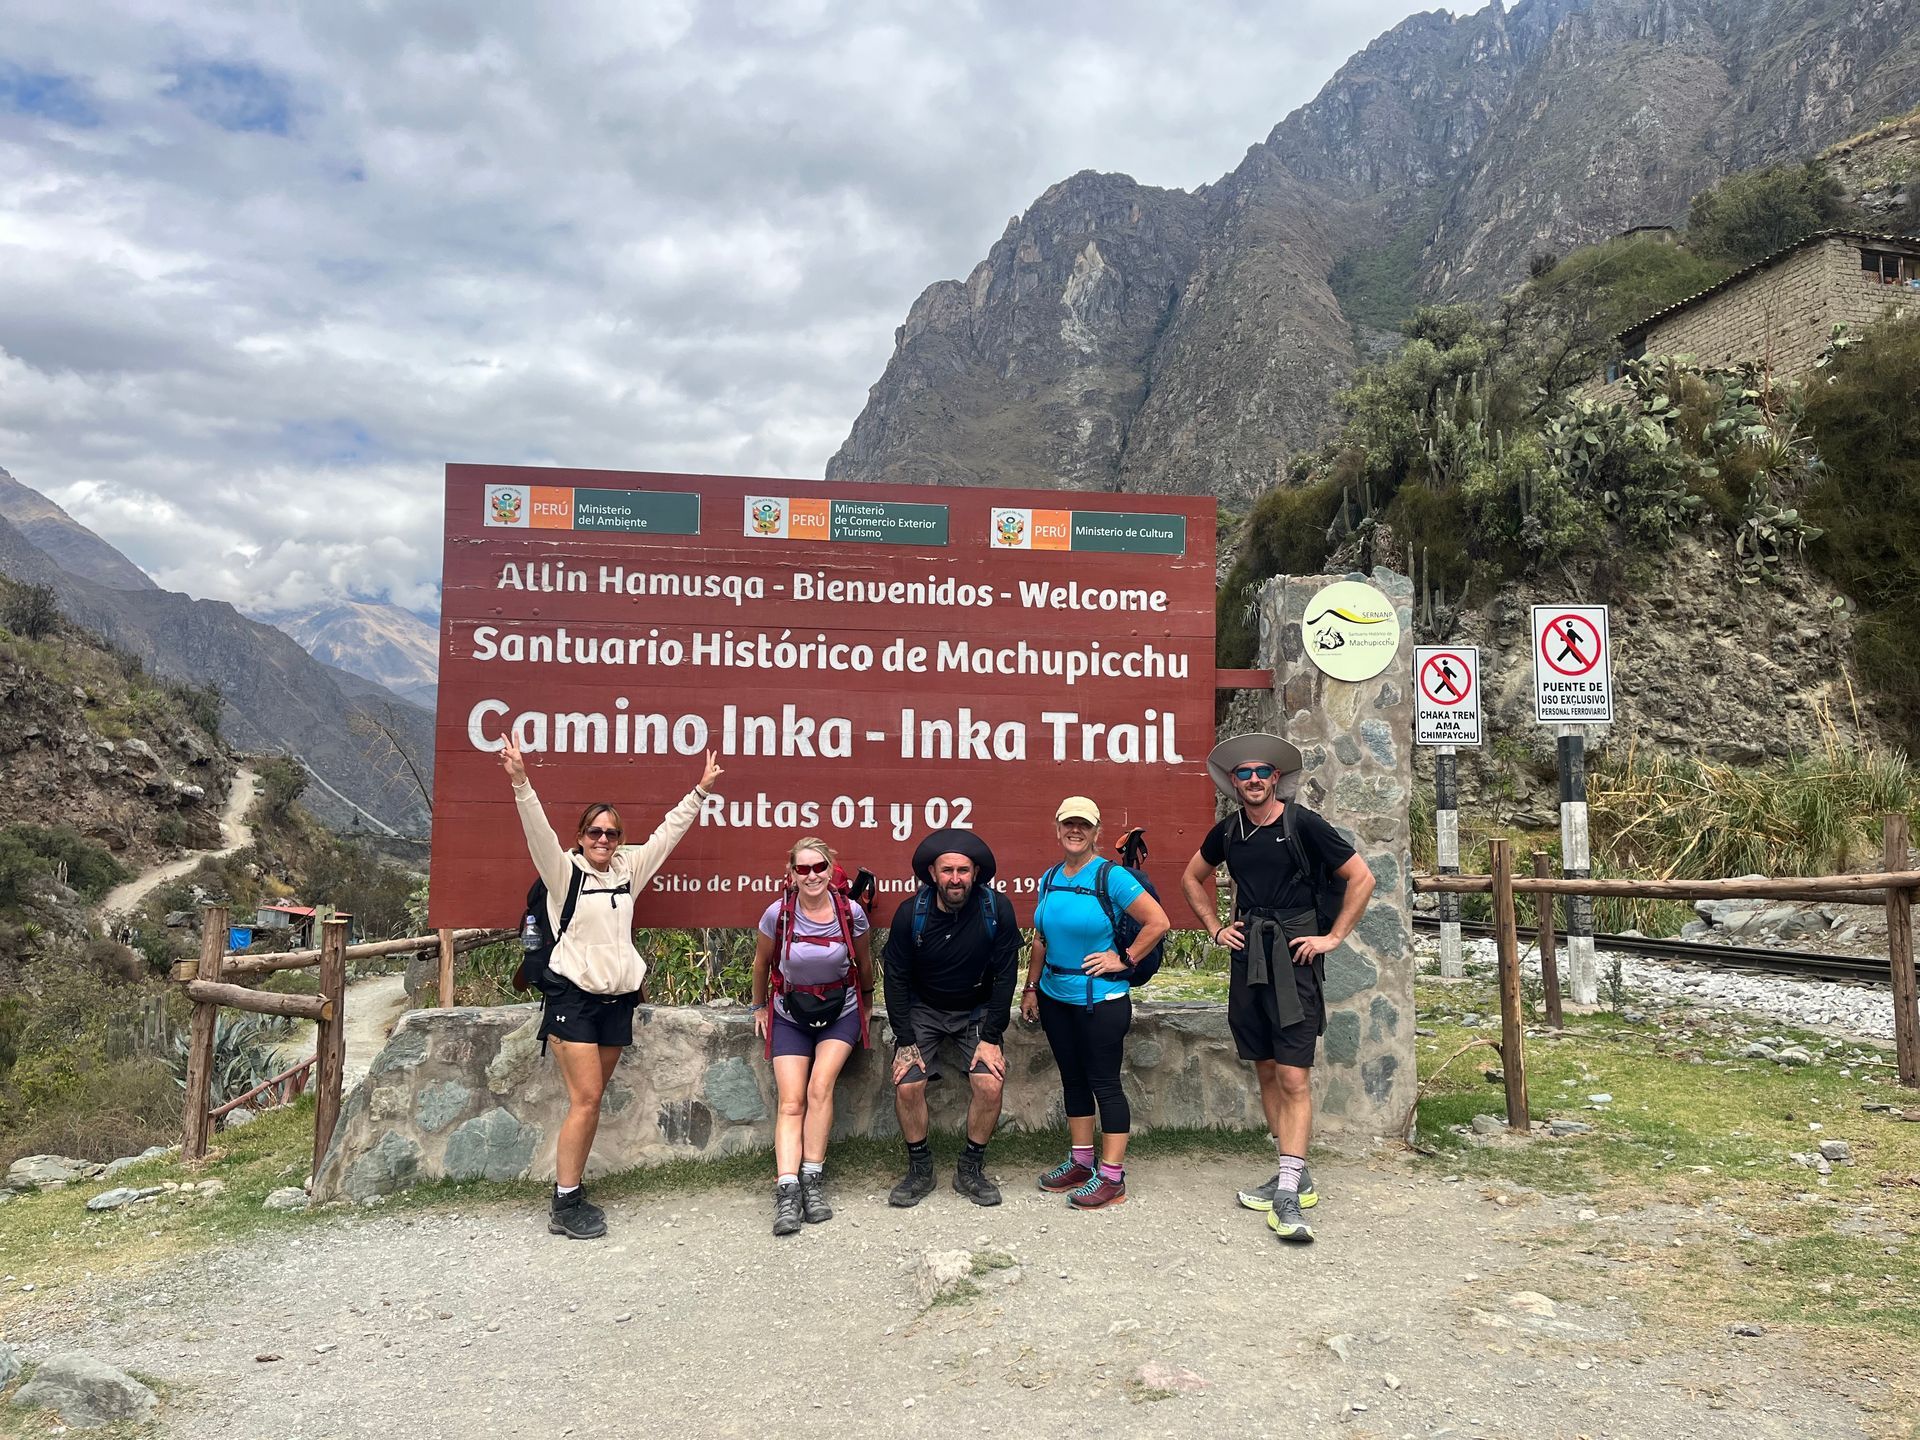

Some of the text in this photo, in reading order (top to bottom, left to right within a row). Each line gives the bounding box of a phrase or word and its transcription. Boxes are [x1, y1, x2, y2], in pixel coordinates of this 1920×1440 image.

[533, 500, 569, 516] PERÚ
[578, 503, 632, 516] Ministerio
[835, 503, 885, 516] Ministerio
[578, 515, 648, 528] del Ambiente
[792, 512, 826, 527] PERÚ
[834, 515, 937, 529] de Comercio Exterior
[834, 526, 882, 538] y Turismo
[1034, 523, 1067, 538] PERÚ
[1075, 526, 1174, 539] Ministerio de Cultura
[497, 561, 587, 592] Allin
[600, 566, 764, 606] Hamusqa
[793, 571, 994, 607] Bienvenidos
[1018, 580, 1168, 612] Welcome
[472, 626, 1189, 685] Santuario Histórico de Machupicchu
[1543, 682, 1603, 692] PUENTE DE
[1541, 694, 1606, 705] USO EXCLUSIVO
[1420, 711, 1475, 719] CHAKA TREN
[1541, 708, 1607, 716] PERSONAL FERROVIARIO
[467, 697, 709, 756] Camino
[722, 704, 854, 758] Inka
[901, 708, 1027, 761] Inka
[1041, 709, 1185, 765] Trail
[1435, 722, 1461, 731] AMA
[1420, 731, 1476, 740] CHIMPAYCHU
[699, 792, 974, 842] Rutas 01 y 02
[652, 873, 702, 893] Sitio
[706, 874, 732, 893] de
